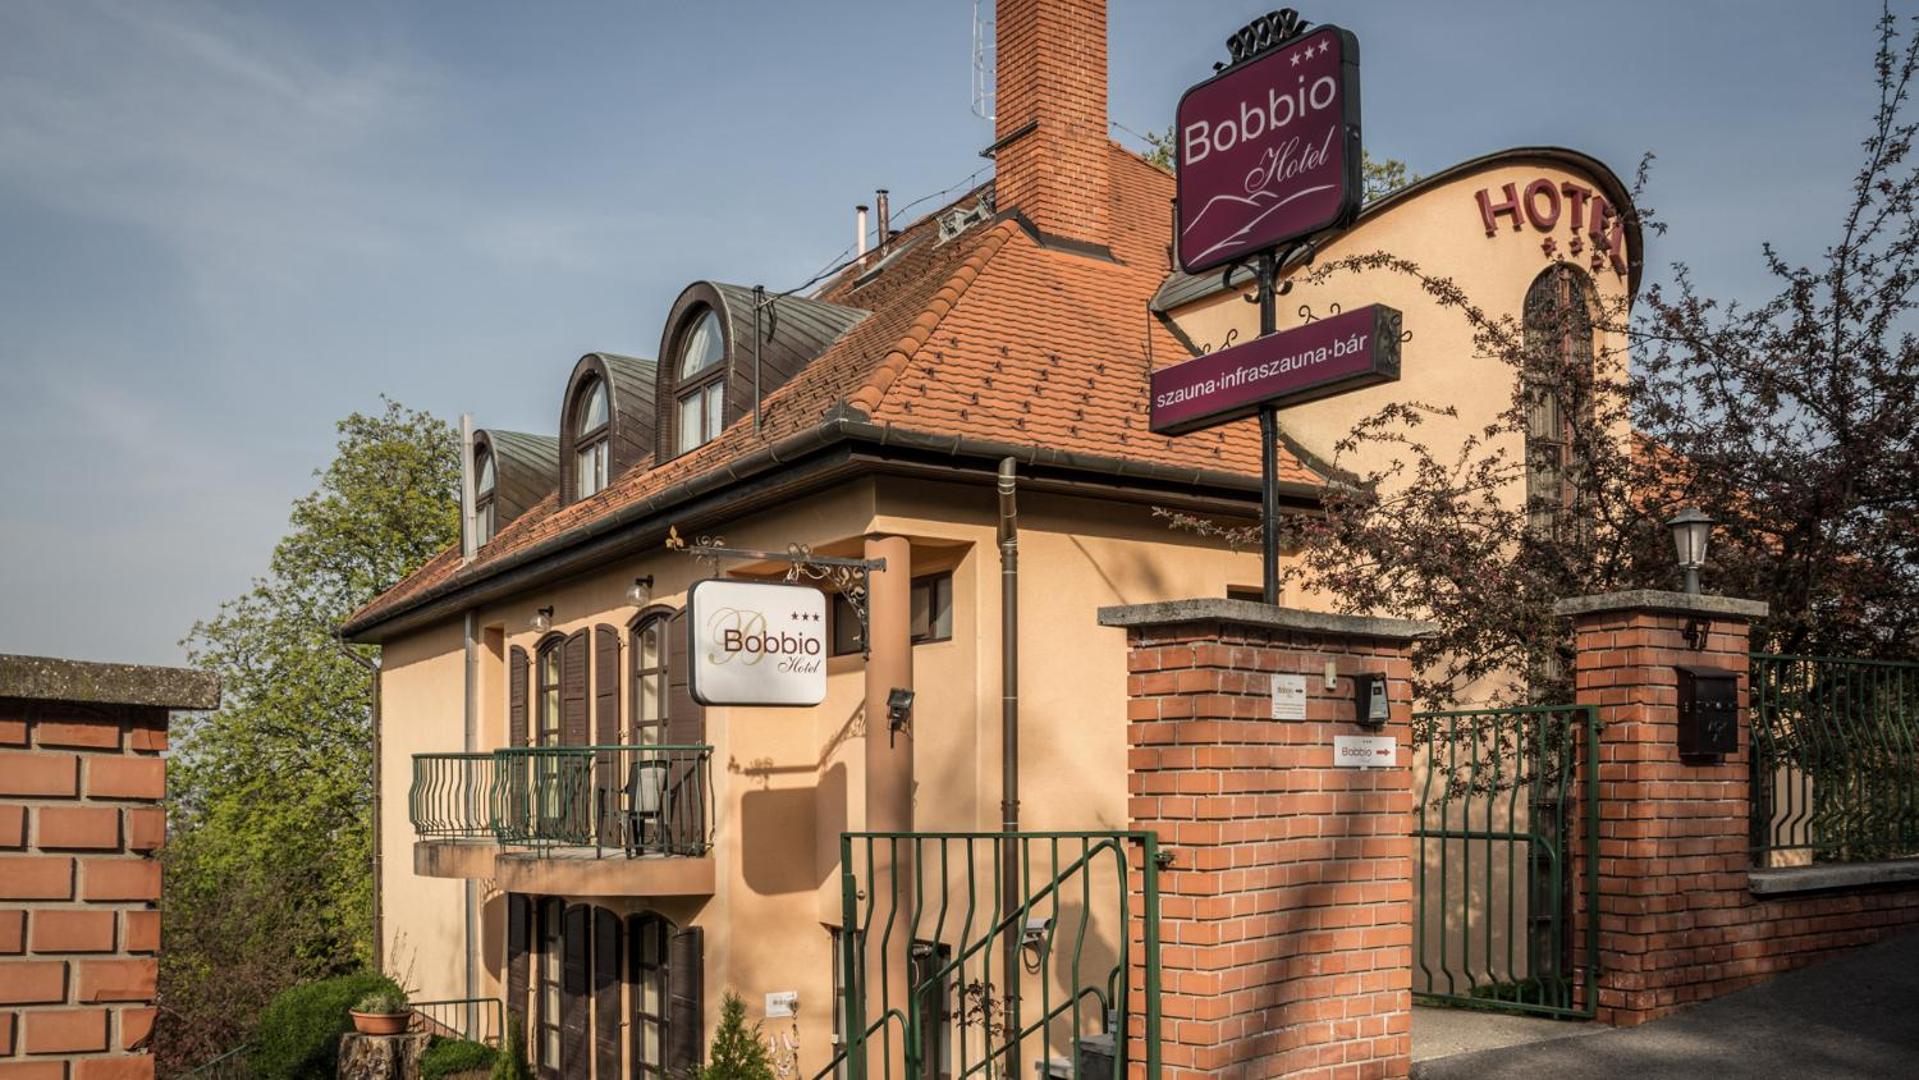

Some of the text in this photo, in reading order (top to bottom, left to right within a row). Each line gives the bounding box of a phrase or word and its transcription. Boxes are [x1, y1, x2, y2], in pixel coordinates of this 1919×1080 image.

[1184, 75, 1336, 166] Bobbio
[1245, 124, 1336, 193] Hotel
[724, 629, 820, 655] Bobbio
[778, 657, 821, 674] Hotel
